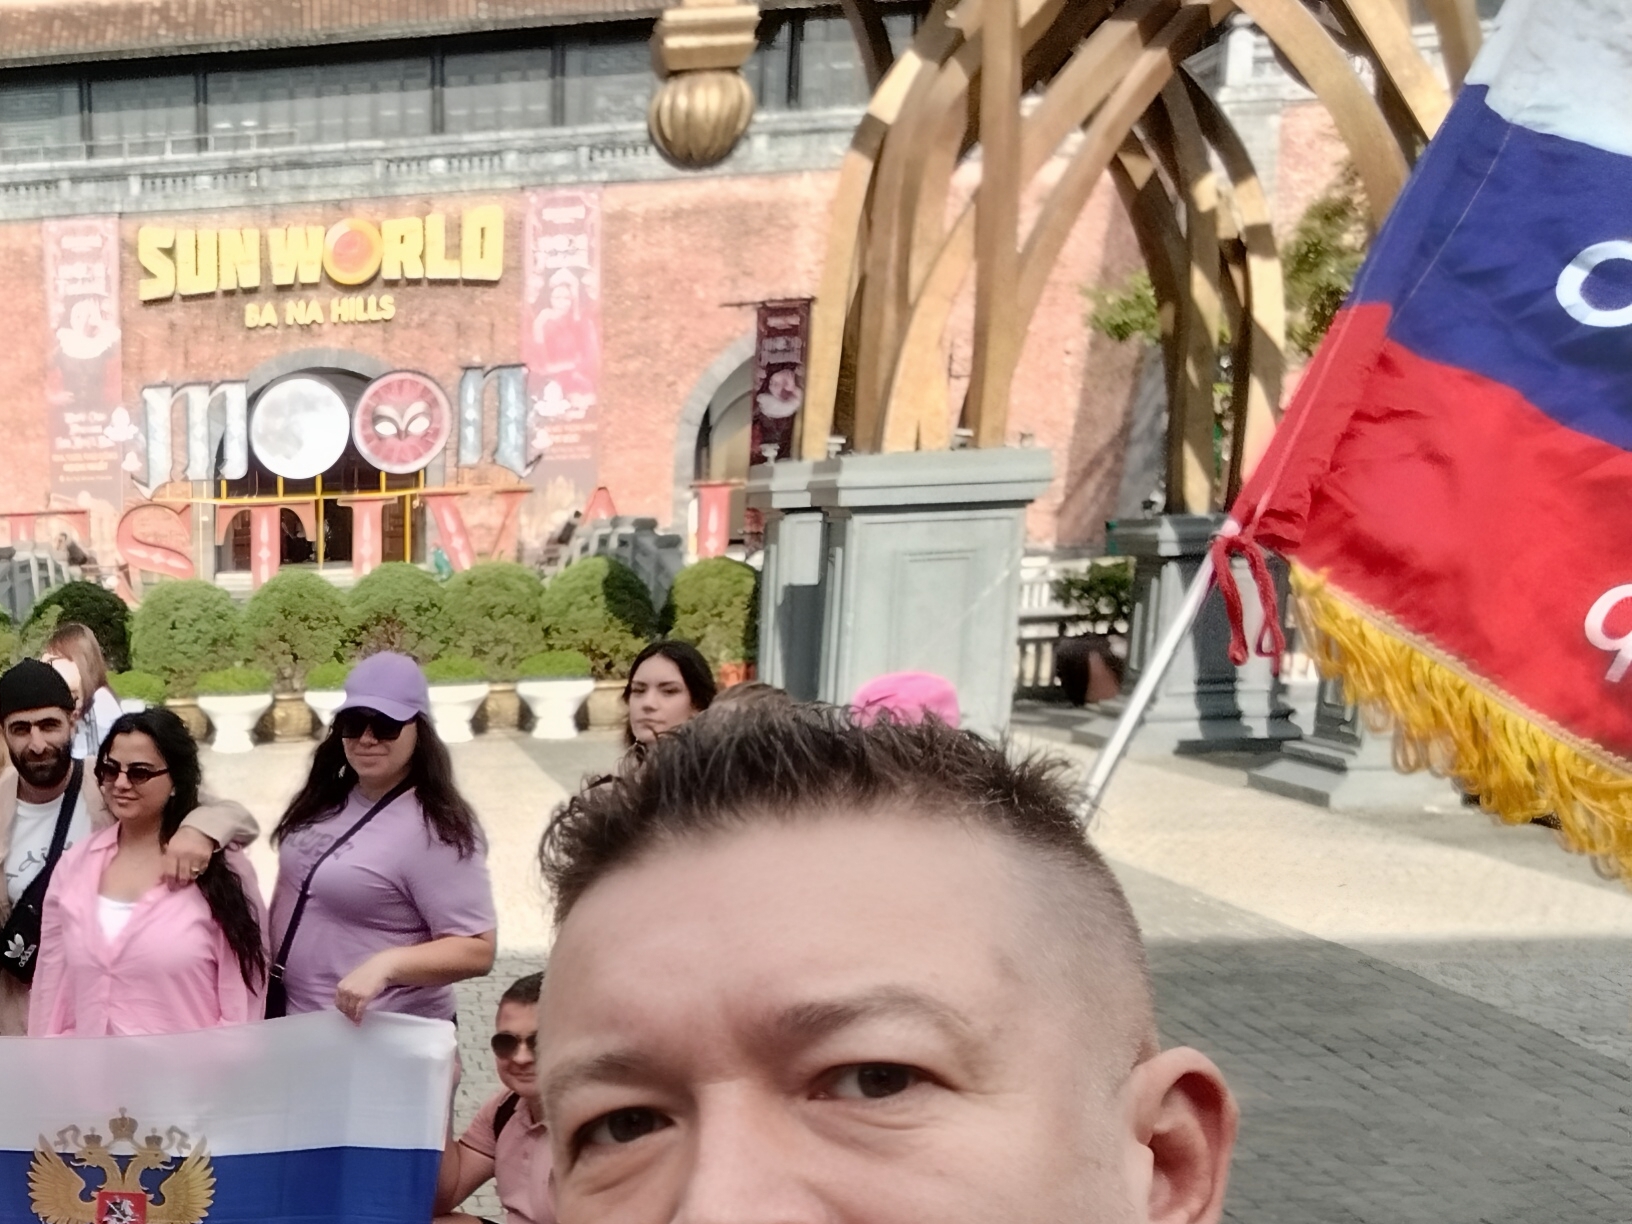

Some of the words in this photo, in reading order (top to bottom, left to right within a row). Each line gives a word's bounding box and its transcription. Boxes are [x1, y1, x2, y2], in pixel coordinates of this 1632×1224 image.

[138, 225, 261, 301] SUN
[267, 204, 505, 287] WORLD
[244, 301, 279, 329] BA
[285, 298, 325, 326] NA
[330, 293, 397, 323] HILLS
